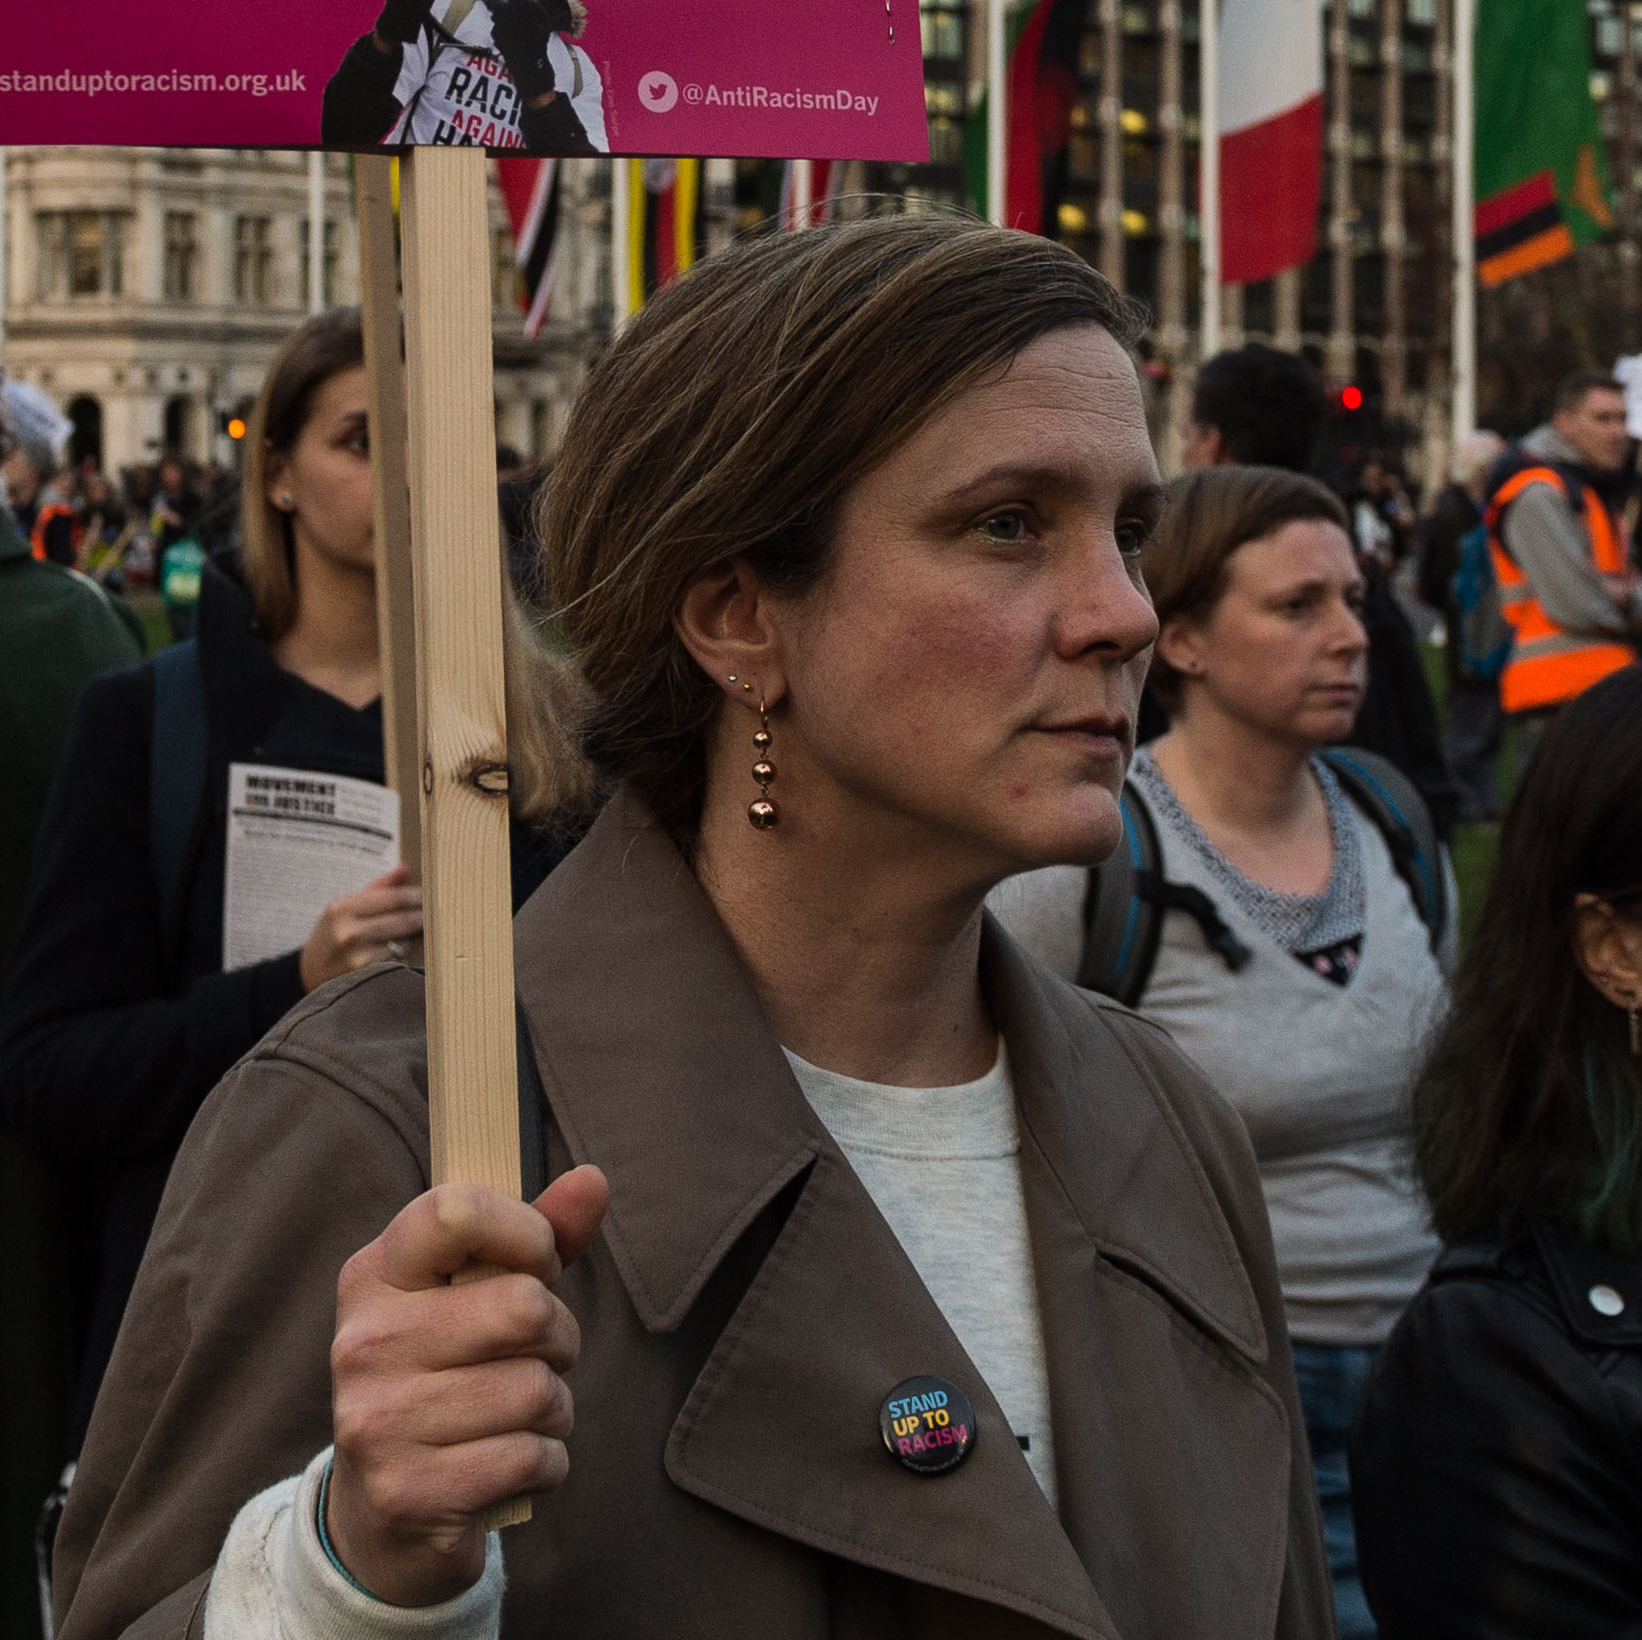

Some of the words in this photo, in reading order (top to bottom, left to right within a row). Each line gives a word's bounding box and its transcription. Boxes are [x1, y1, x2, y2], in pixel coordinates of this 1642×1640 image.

[683, 83, 880, 116] @AntiRacismDay
[888, 1390, 948, 1419] STAND
[893, 1416, 920, 1436] UP
[922, 1409, 950, 1430] TO
[898, 1424, 969, 1456] RACISM
